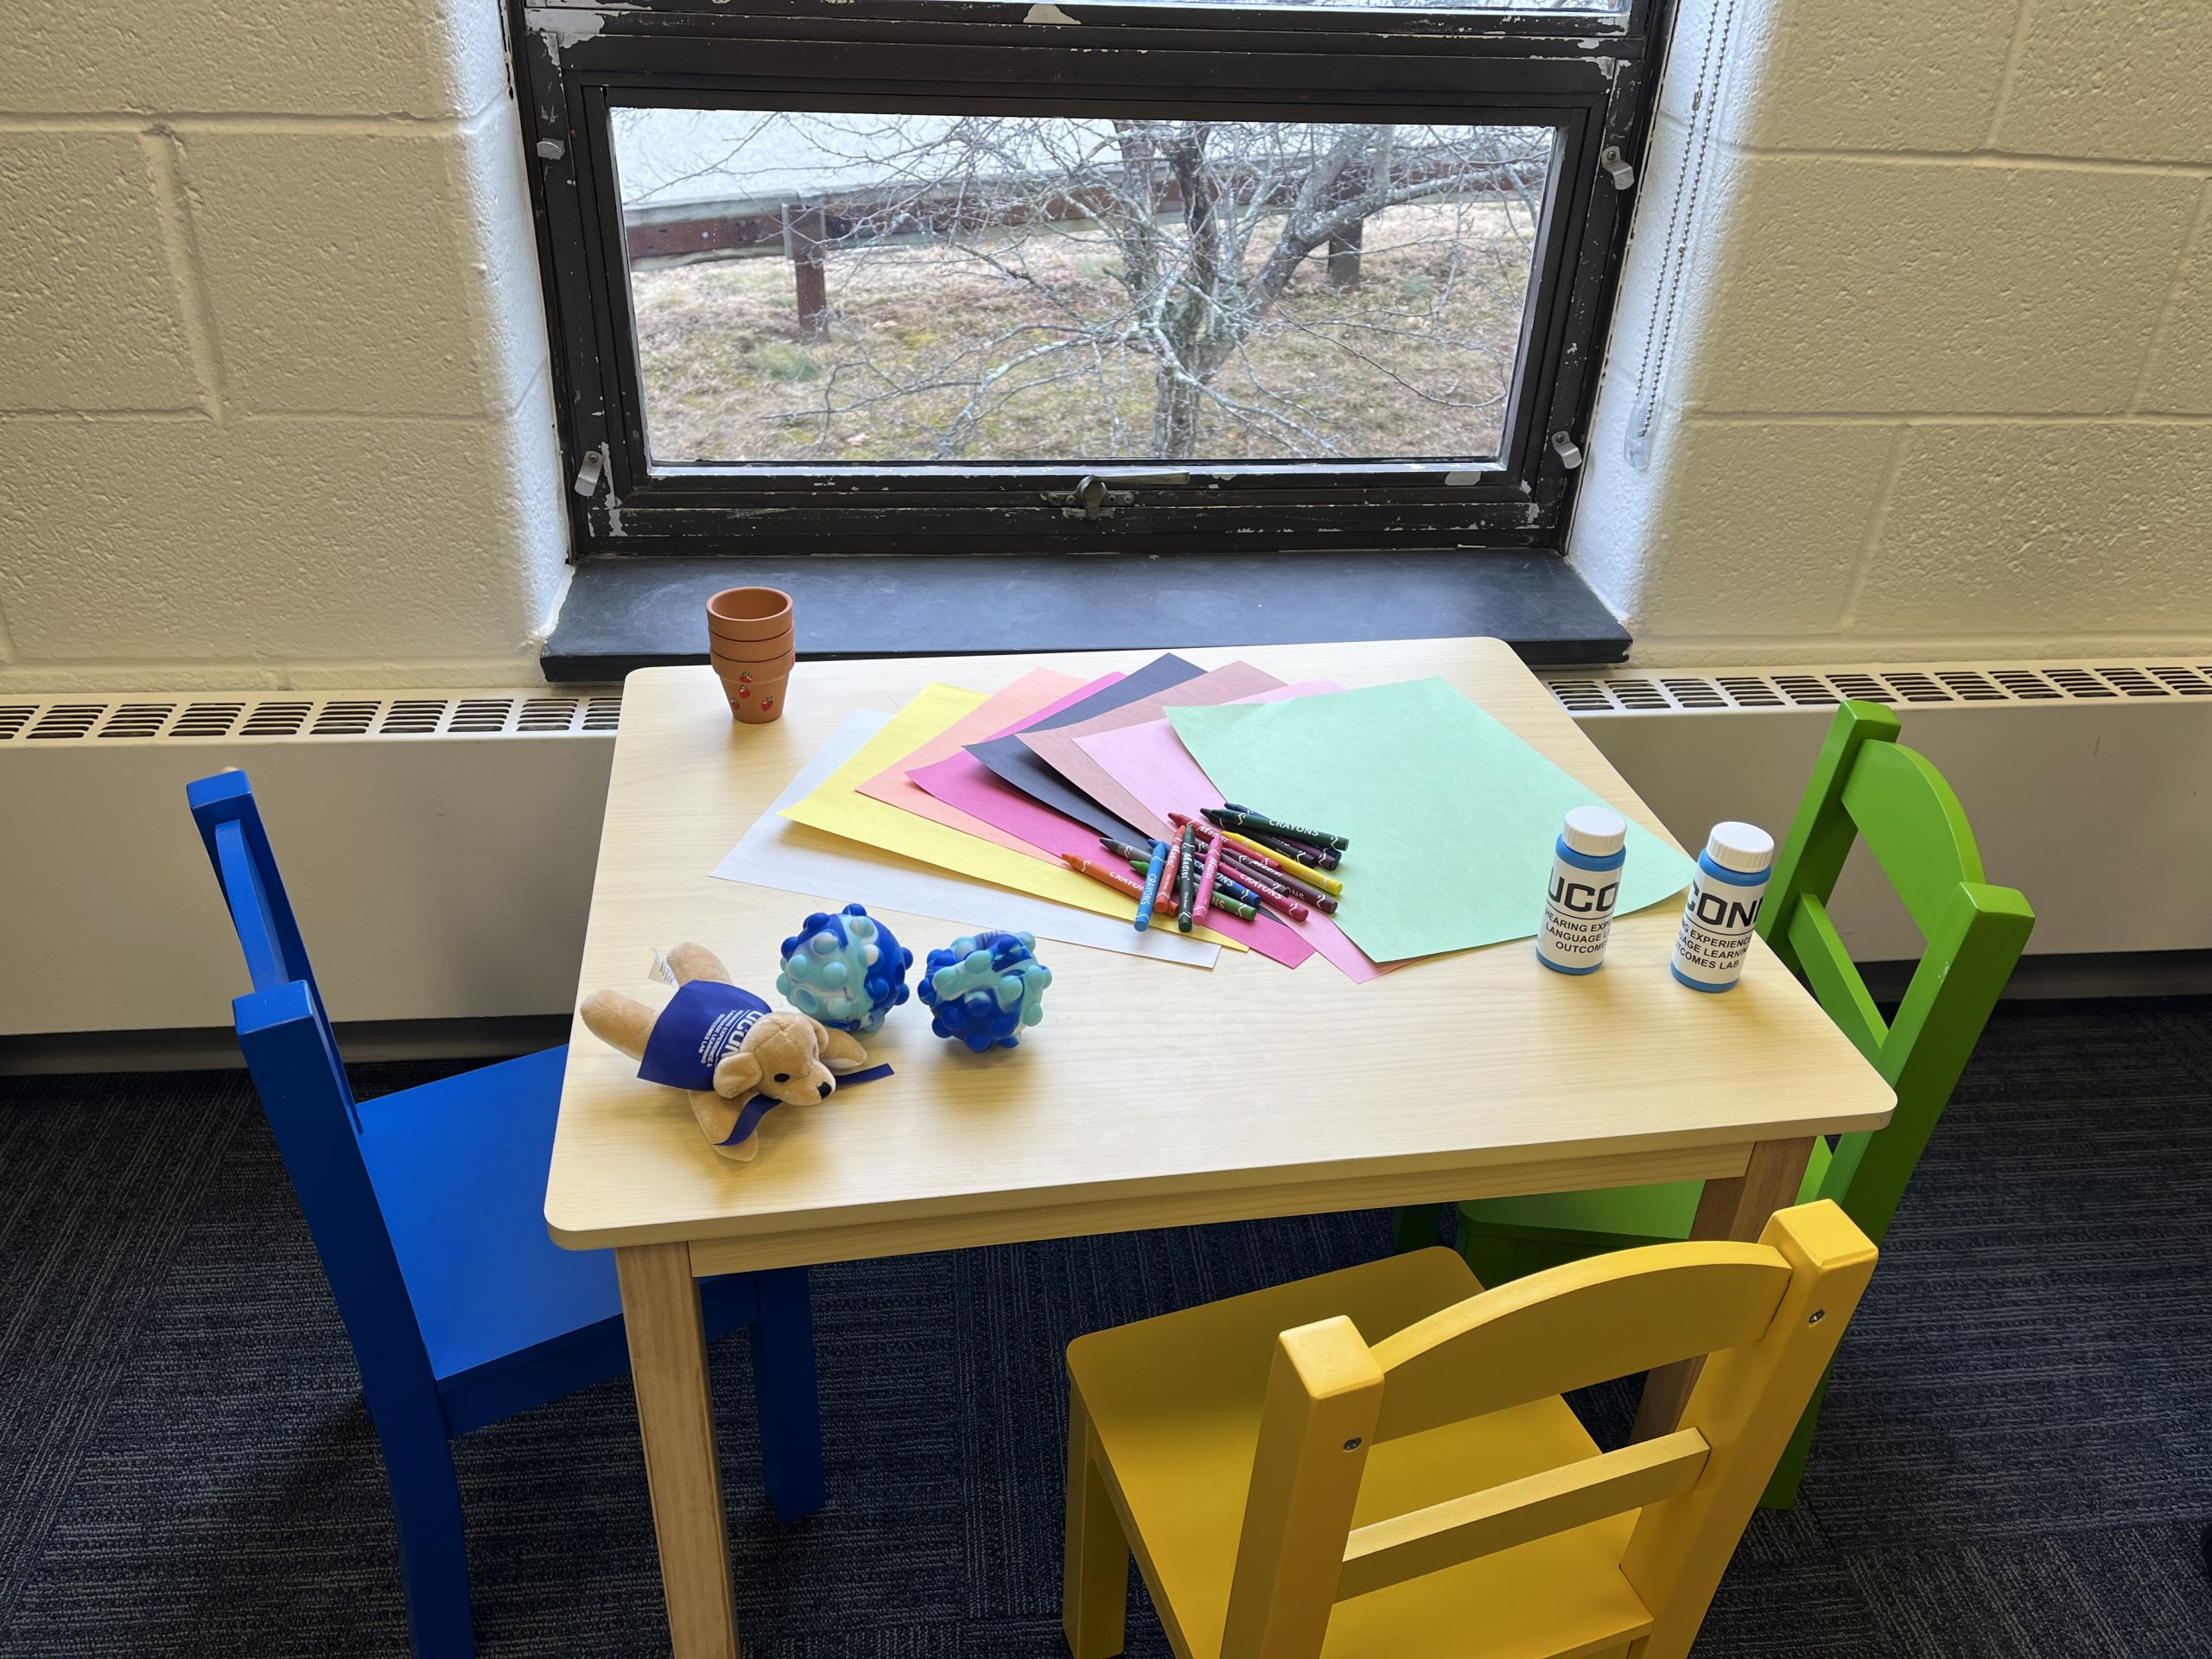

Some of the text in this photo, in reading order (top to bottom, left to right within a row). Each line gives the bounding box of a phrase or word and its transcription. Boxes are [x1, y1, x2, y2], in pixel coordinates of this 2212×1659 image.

[1268, 819, 1320, 837] CRAYONS
[1181, 852, 1192, 879] Madisi
[1141, 874, 1157, 906] CRAYONS
[1240, 874, 1284, 899] CRAYONS
[1546, 907, 1588, 932] HEARING
[1546, 922, 1602, 944] LANGUAGE
[1719, 960, 1739, 969] LAB
[698, 1040, 708, 1053] LAB
